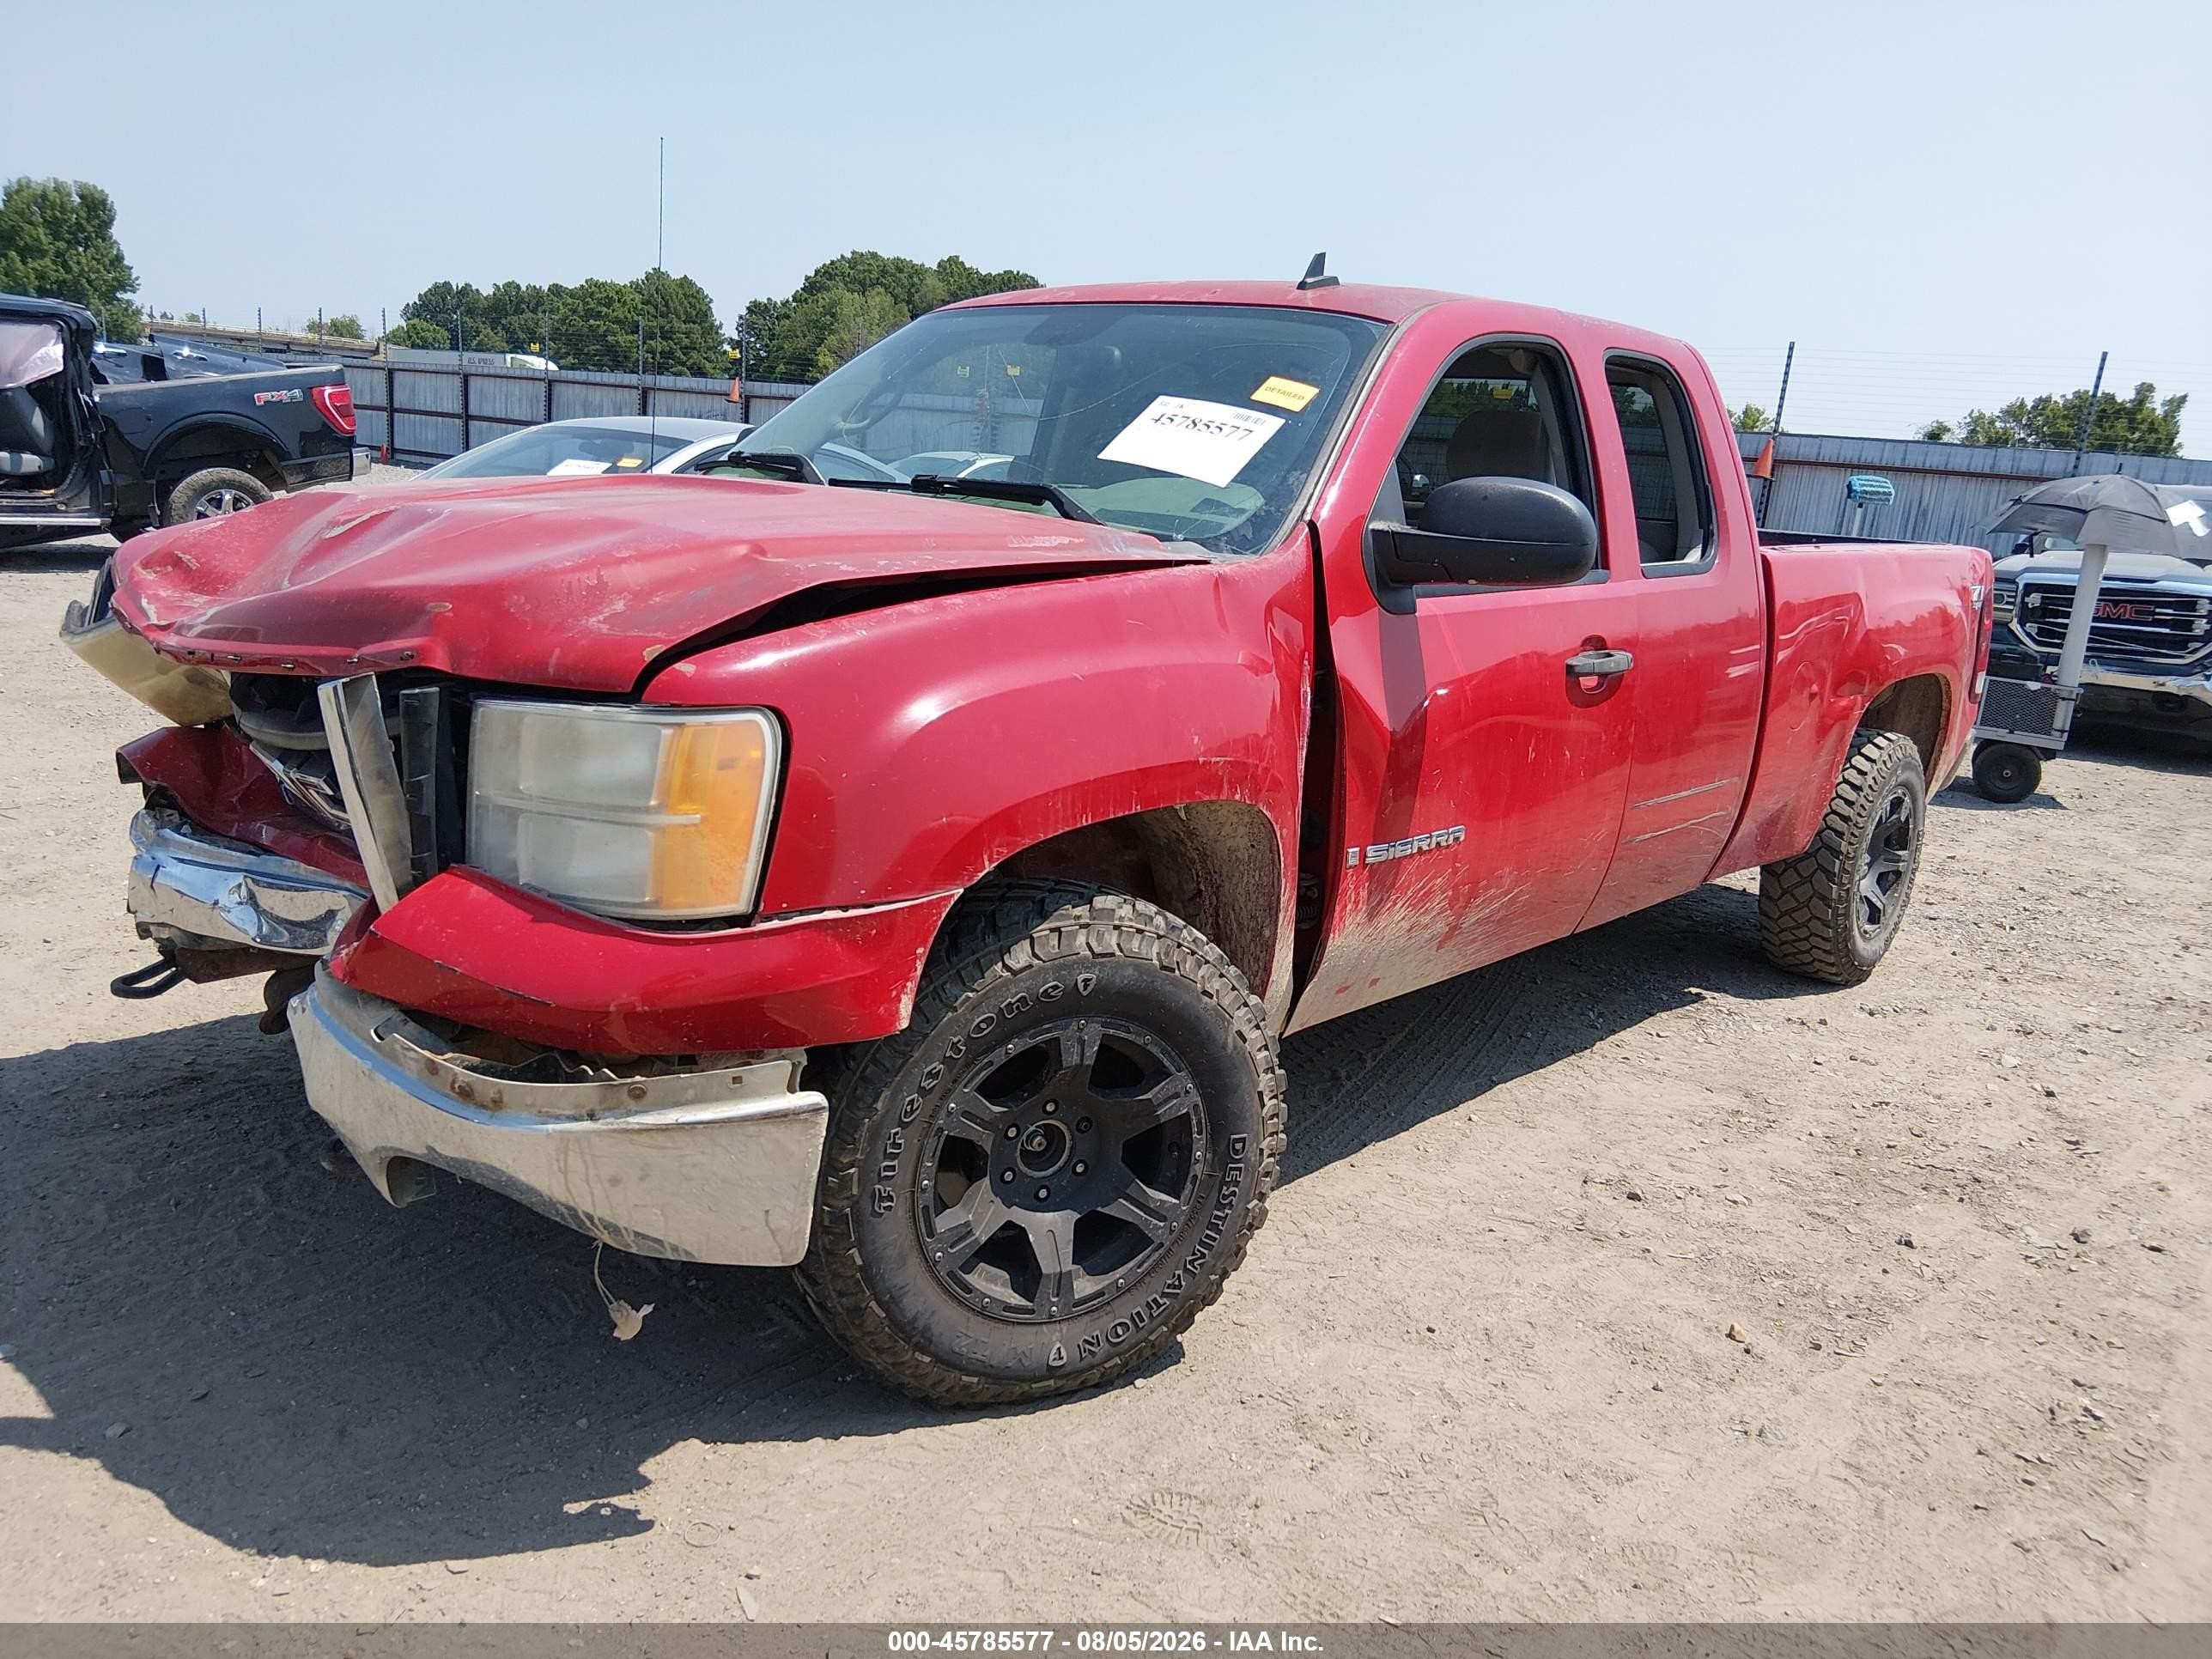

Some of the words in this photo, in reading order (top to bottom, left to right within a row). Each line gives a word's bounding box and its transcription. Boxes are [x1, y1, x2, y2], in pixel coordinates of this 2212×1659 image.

[254, 389, 303, 405] FX4
[1264, 386, 1305, 401] DETAILED
[1150, 412, 1254, 441] 45785577
[1365, 825, 1466, 864] SIERRA
[874, 981, 1065, 1213] Firestone
[1079, 1133, 1249, 1360] DESTINATION
